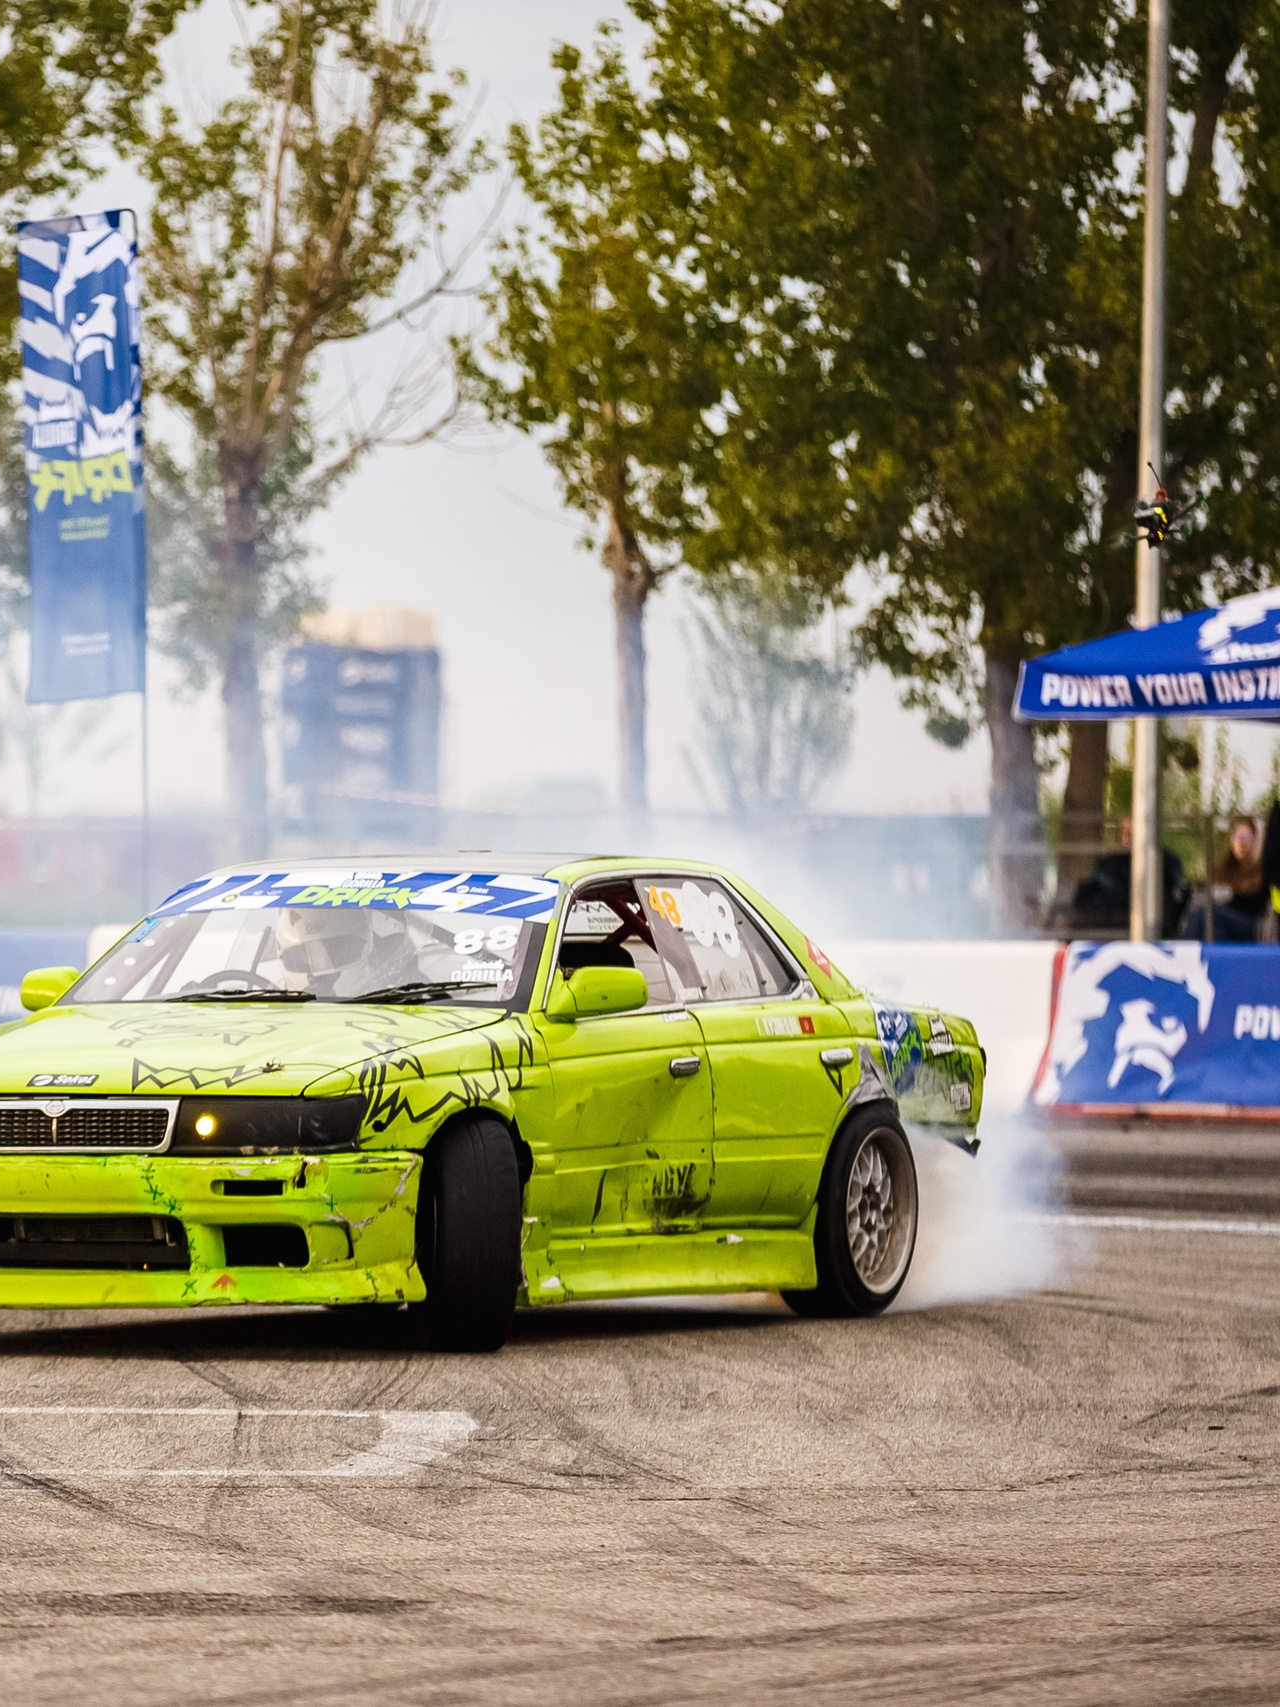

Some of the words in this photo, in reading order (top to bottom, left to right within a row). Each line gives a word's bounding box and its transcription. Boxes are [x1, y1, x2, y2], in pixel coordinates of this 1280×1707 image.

[1041, 672, 1133, 707] POWER
[1135, 672, 1208, 707] YOUR
[286, 885, 421, 909] DRIFT
[648, 885, 681, 925] 48
[681, 880, 741, 959] 88
[453, 924, 519, 956] 88
[451, 968, 514, 982] GORILLA
